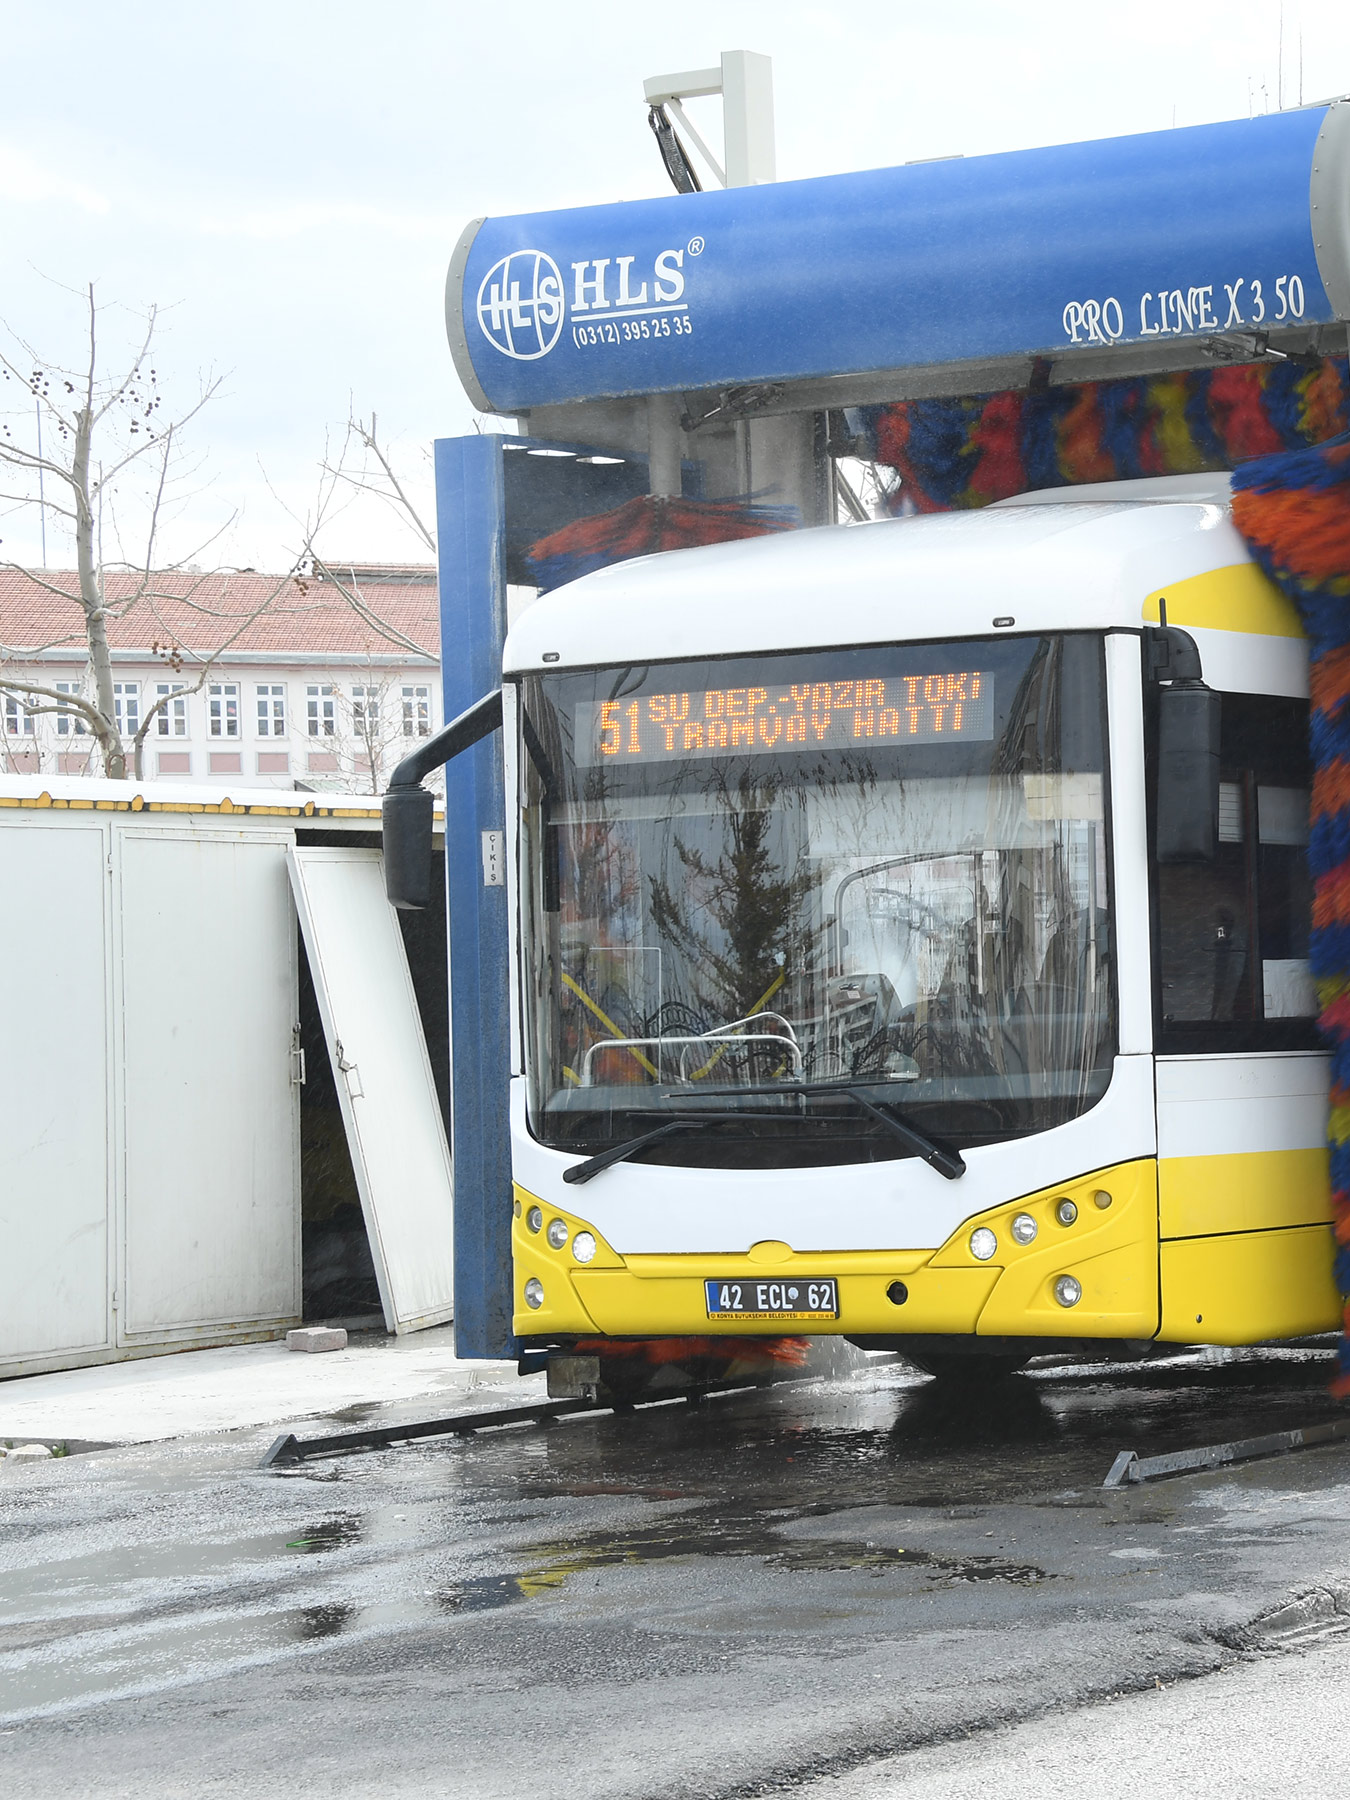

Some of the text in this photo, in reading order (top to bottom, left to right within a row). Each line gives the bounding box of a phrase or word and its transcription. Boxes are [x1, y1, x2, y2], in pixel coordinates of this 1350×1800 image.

[490, 276, 560, 331] HLS
[1063, 297, 1124, 346] PRO
[1140, 285, 1217, 336] LINE
[572, 315, 692, 350] (0312) 395 25 35
[601, 701, 641, 754] 51
[649, 693, 689, 722] SU
[661, 703, 962, 751] TRAMVAY HATTI
[719, 1284, 832, 1309] 42 ECL 62
